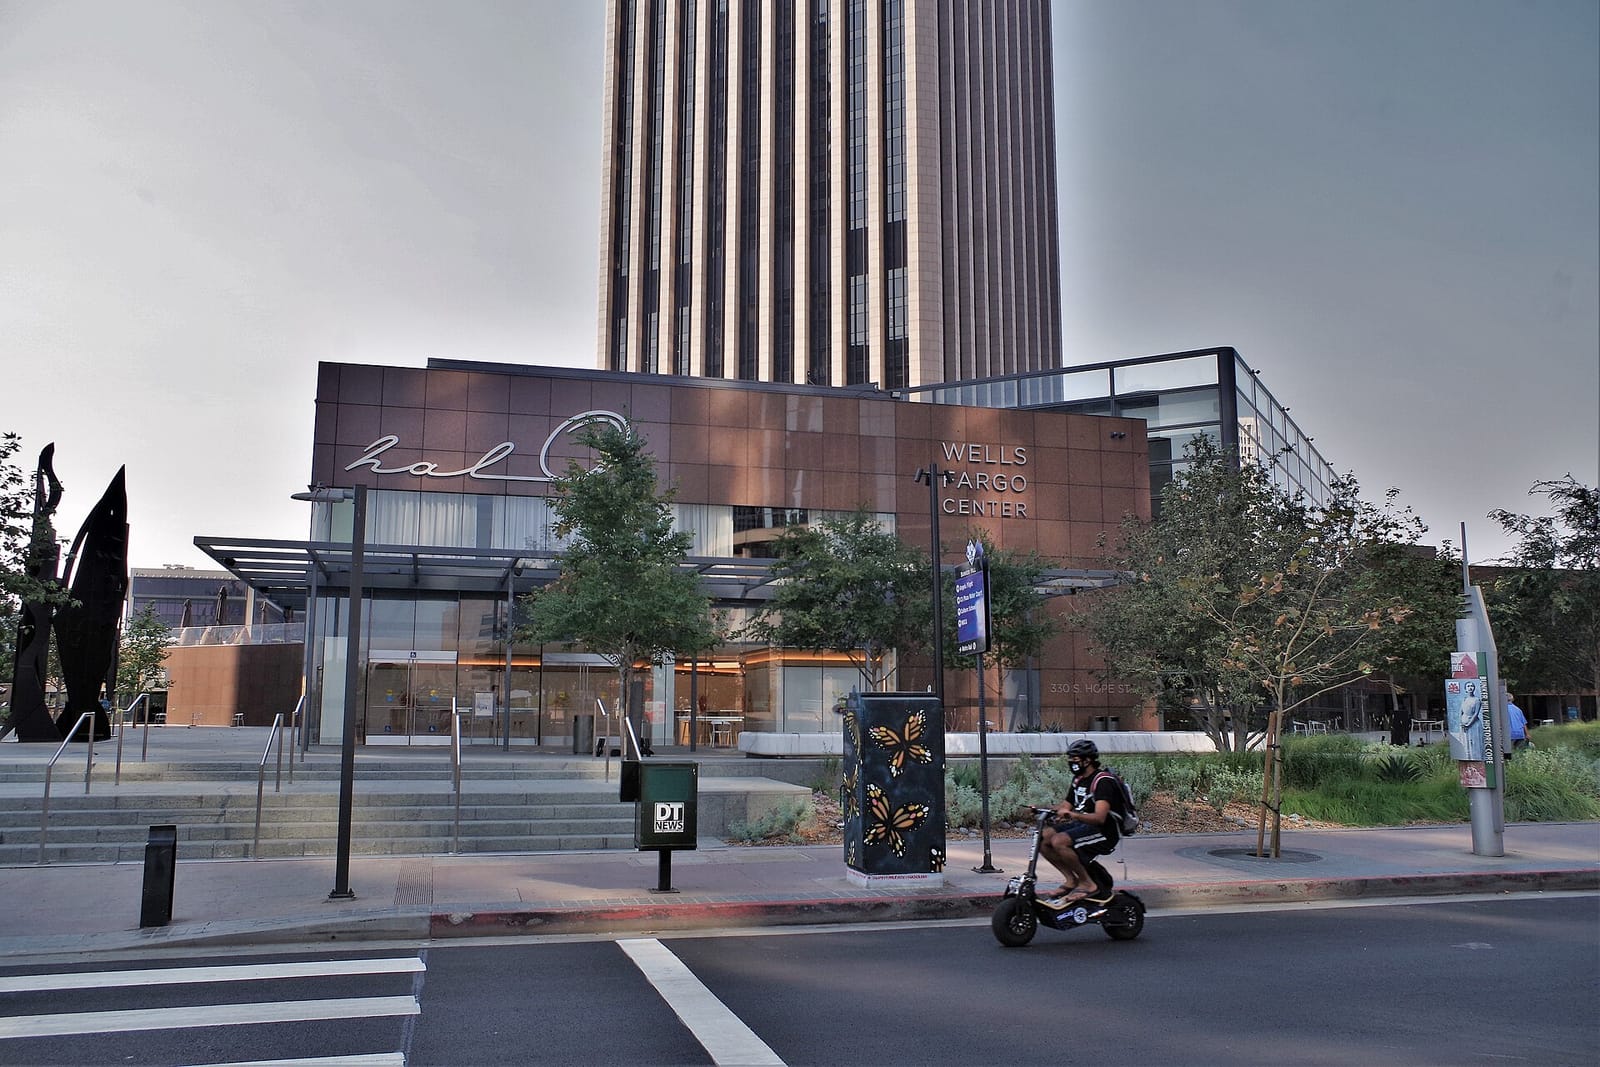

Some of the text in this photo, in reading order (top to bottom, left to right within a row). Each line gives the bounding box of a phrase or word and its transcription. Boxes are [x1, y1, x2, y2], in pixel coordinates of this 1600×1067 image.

[942, 442, 1027, 465] WELLS
[943, 471, 1027, 492] FARGO
[943, 498, 1027, 517] CENTER
[1050, 683, 1070, 693] 330
[1085, 683, 1115, 694] HOPE
[1480, 676, 1489, 699] BUNKER
[1482, 701, 1490, 712] HILL
[1483, 719, 1493, 747] HISTORIC
[1485, 748, 1493, 764] CORE
[656, 803, 682, 820] DT
[655, 821, 683, 829] NEWS
